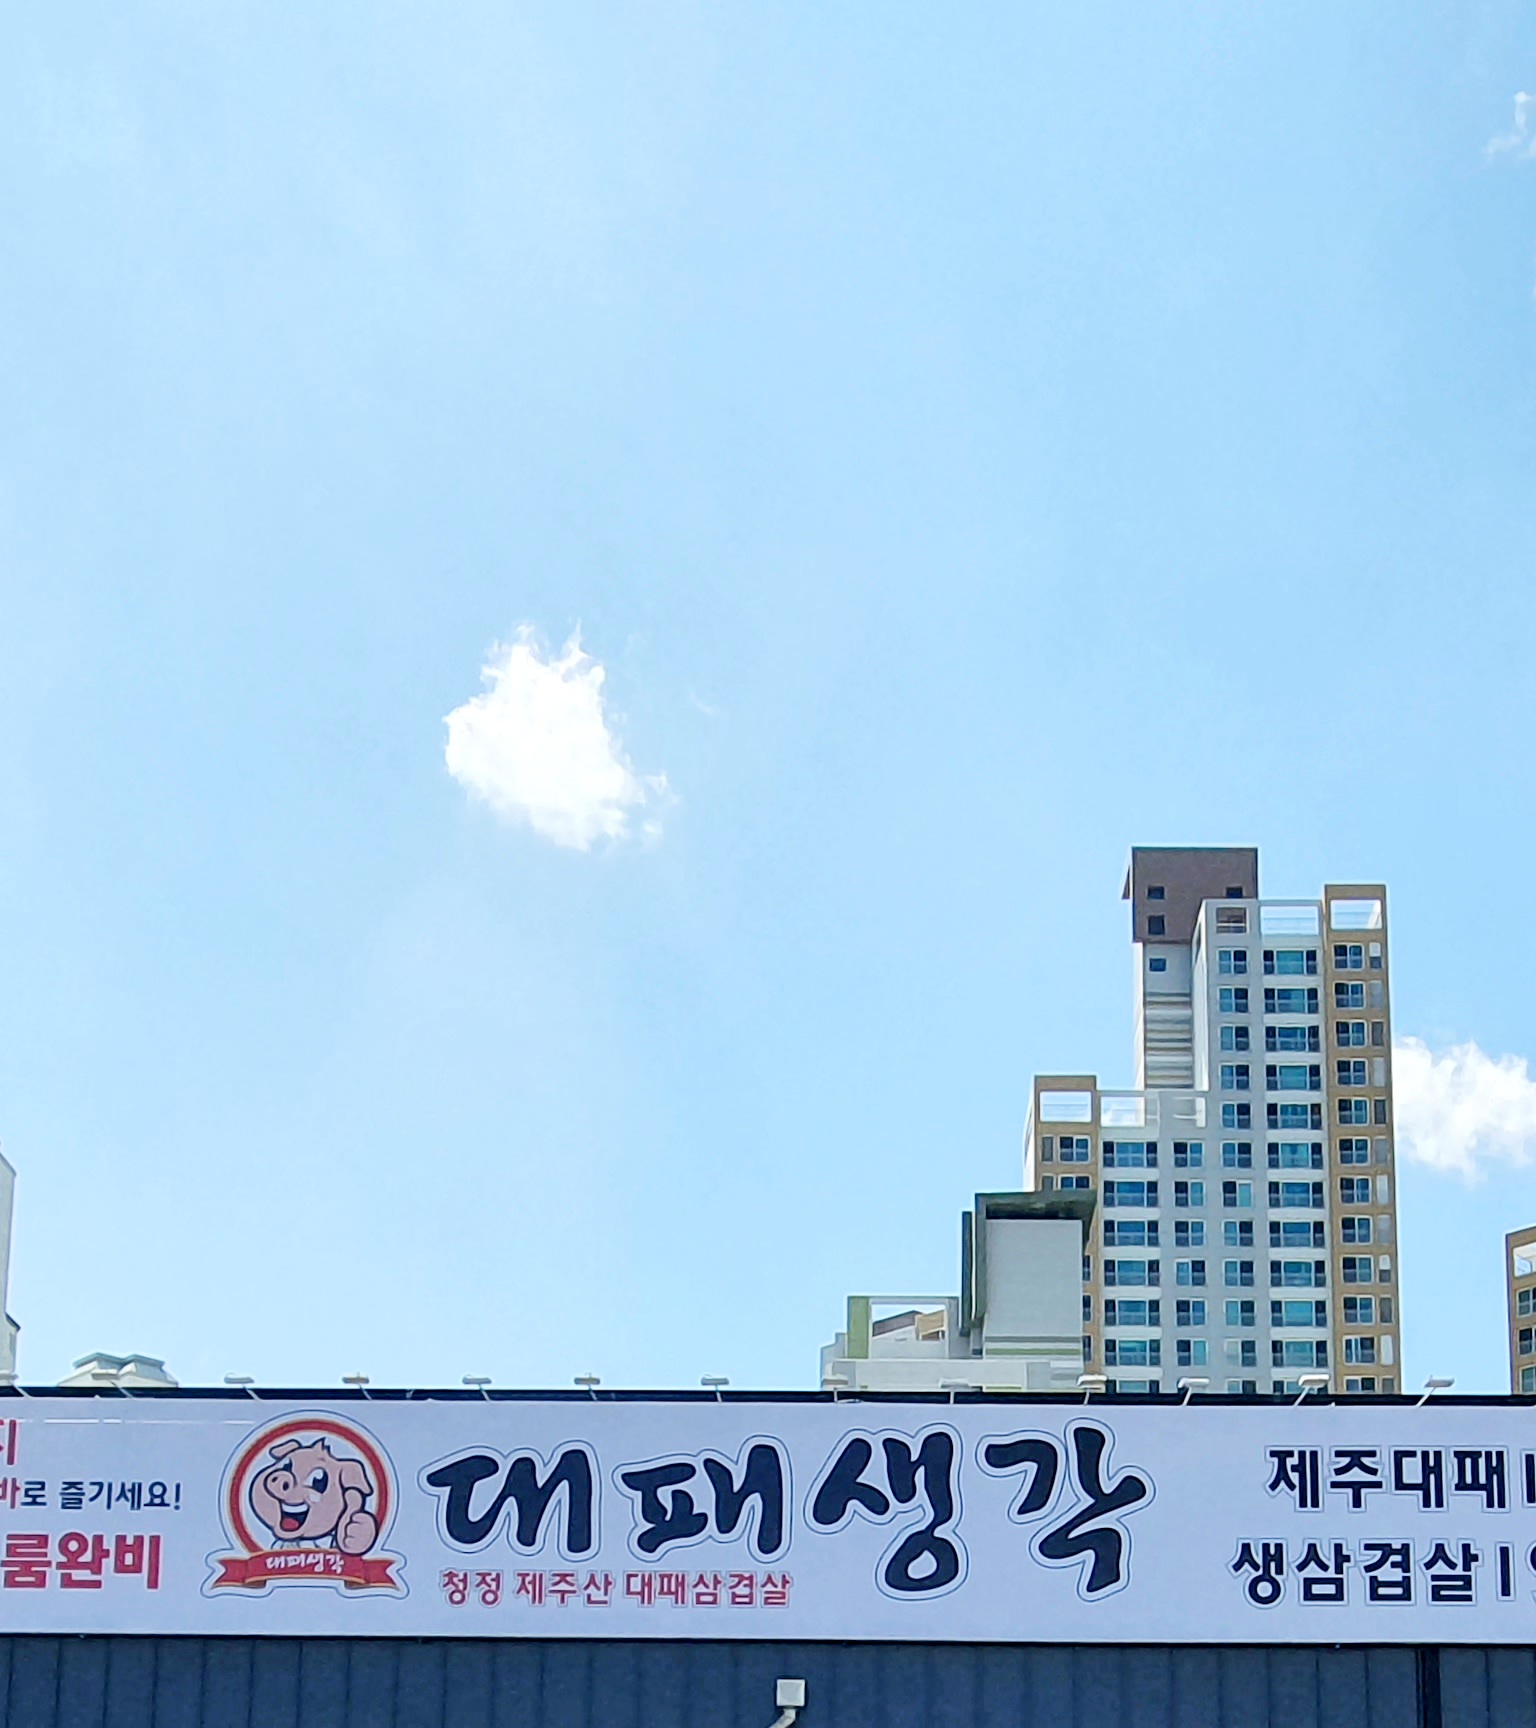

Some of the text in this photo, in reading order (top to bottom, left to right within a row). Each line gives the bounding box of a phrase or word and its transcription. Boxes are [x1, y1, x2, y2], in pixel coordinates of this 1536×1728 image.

[58, 1477, 182, 1512] 즐기세요!
[426, 1427, 1148, 1593] 대패생각
[441, 1570, 793, 1607] 청정 제주산 대패삼겹살
